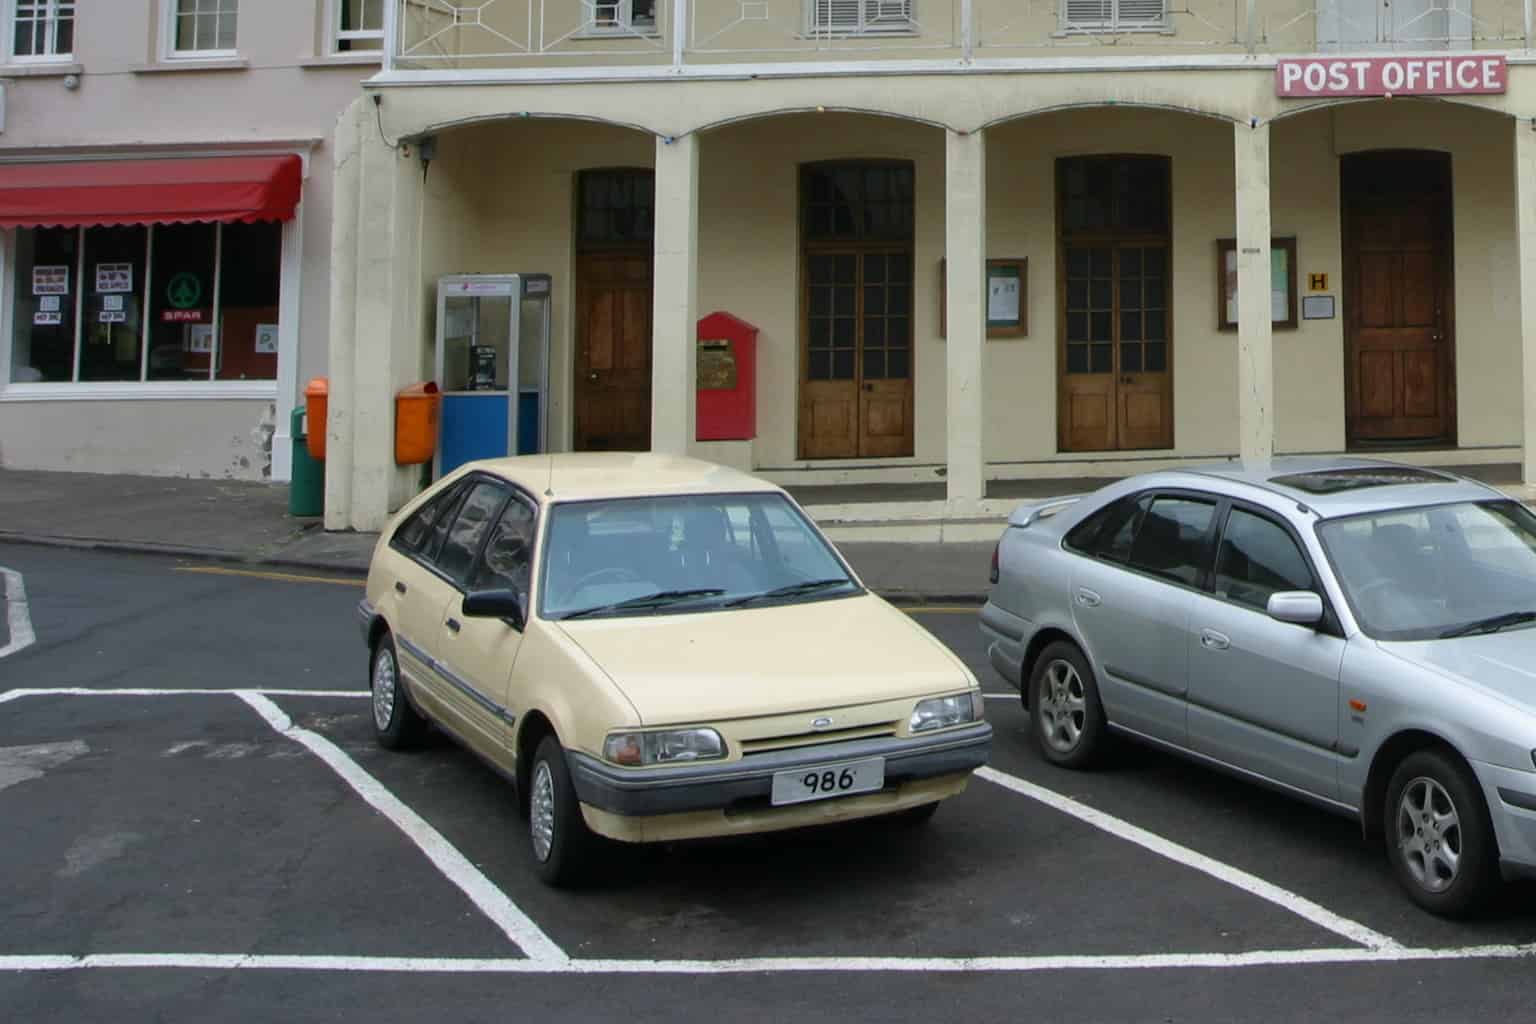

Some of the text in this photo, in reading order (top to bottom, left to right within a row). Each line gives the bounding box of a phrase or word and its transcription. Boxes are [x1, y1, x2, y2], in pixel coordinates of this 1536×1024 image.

[1283, 59, 1501, 92] POST OFFICE
[1312, 273, 1325, 289] H
[163, 311, 201, 321] SPAR
[803, 768, 853, 794] 986
